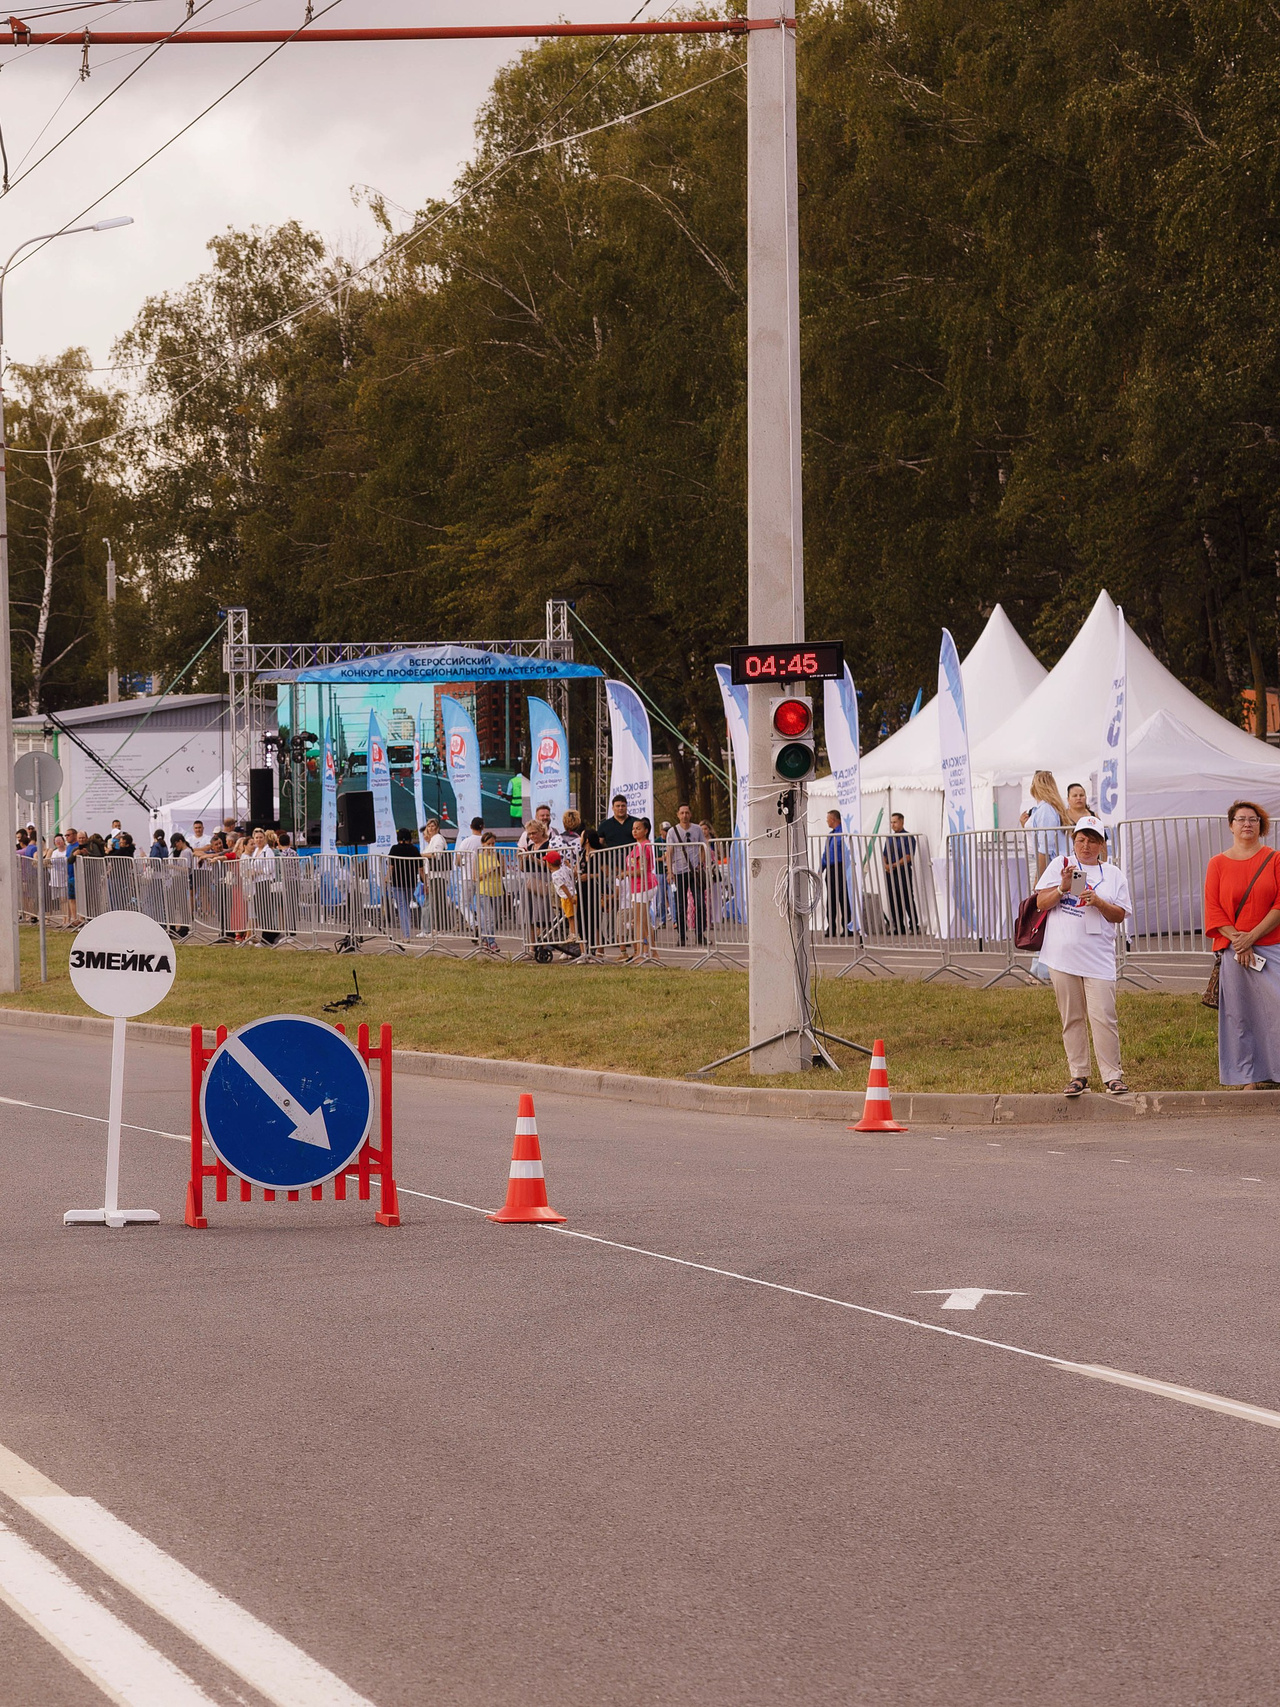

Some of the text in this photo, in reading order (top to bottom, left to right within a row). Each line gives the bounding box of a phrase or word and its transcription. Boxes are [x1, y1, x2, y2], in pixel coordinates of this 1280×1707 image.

[409, 656, 492, 667] ВСЕРОССИЙСКИЙ
[745, 653, 818, 677] 04:45
[340, 665, 559, 678] КОНКУРС ПРОФЕССИОНАЛЬНОГО МАСТЕРСТВА
[69, 949, 172, 974] ЗМЕЙКА
